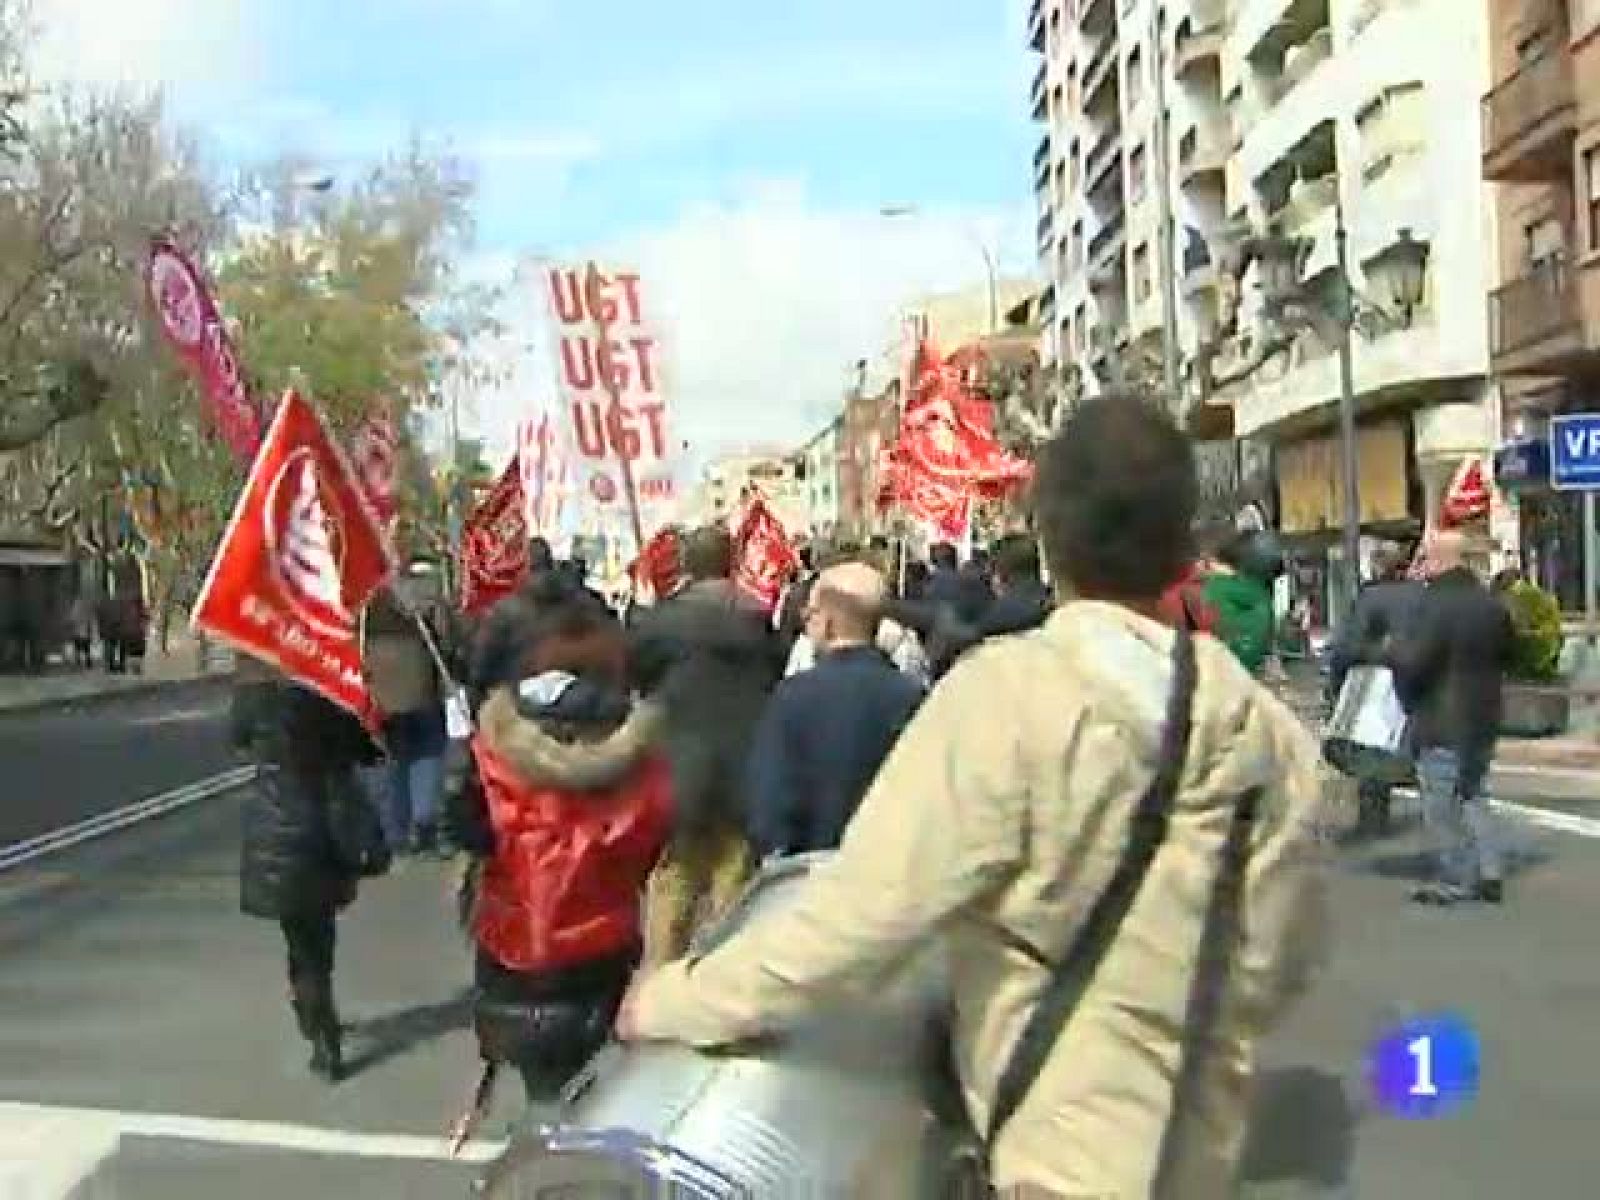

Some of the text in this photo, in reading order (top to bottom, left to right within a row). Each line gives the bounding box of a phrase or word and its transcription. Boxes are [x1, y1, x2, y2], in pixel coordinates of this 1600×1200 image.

[549, 268, 641, 324] UGT
[560, 337, 654, 392] UGT
[573, 401, 665, 459] UGT
